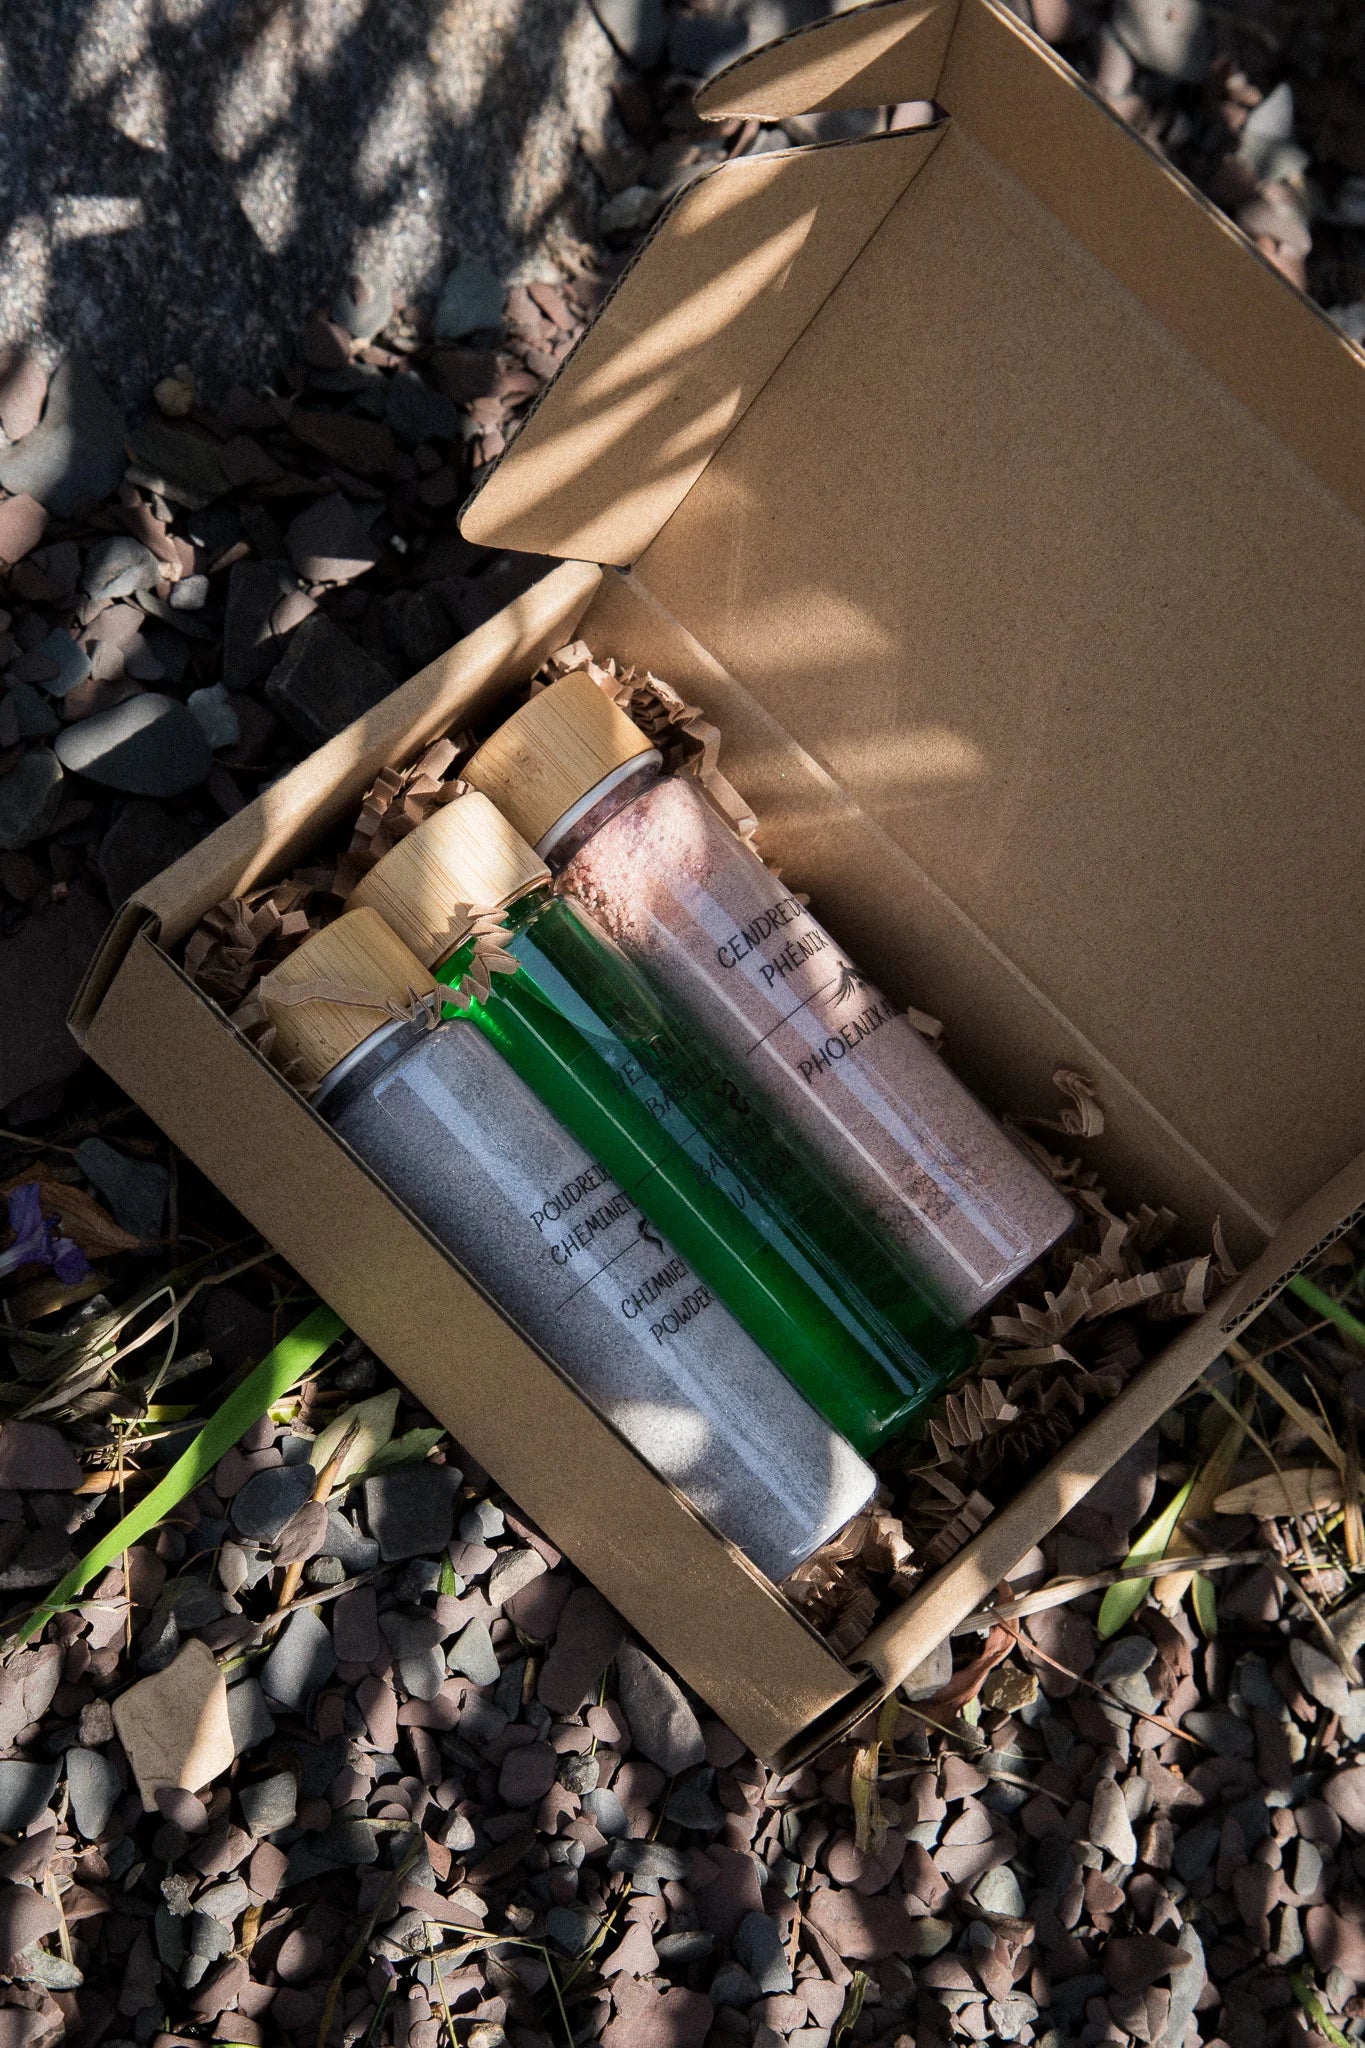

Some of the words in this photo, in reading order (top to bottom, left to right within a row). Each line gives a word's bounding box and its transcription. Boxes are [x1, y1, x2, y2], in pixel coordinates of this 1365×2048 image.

[758, 930, 829, 988] PHÉNIX
[797, 1004, 888, 1085] PHOENIX
[621, 1257, 689, 1319] CHIMNEY
[649, 1285, 715, 1346] POWDER
